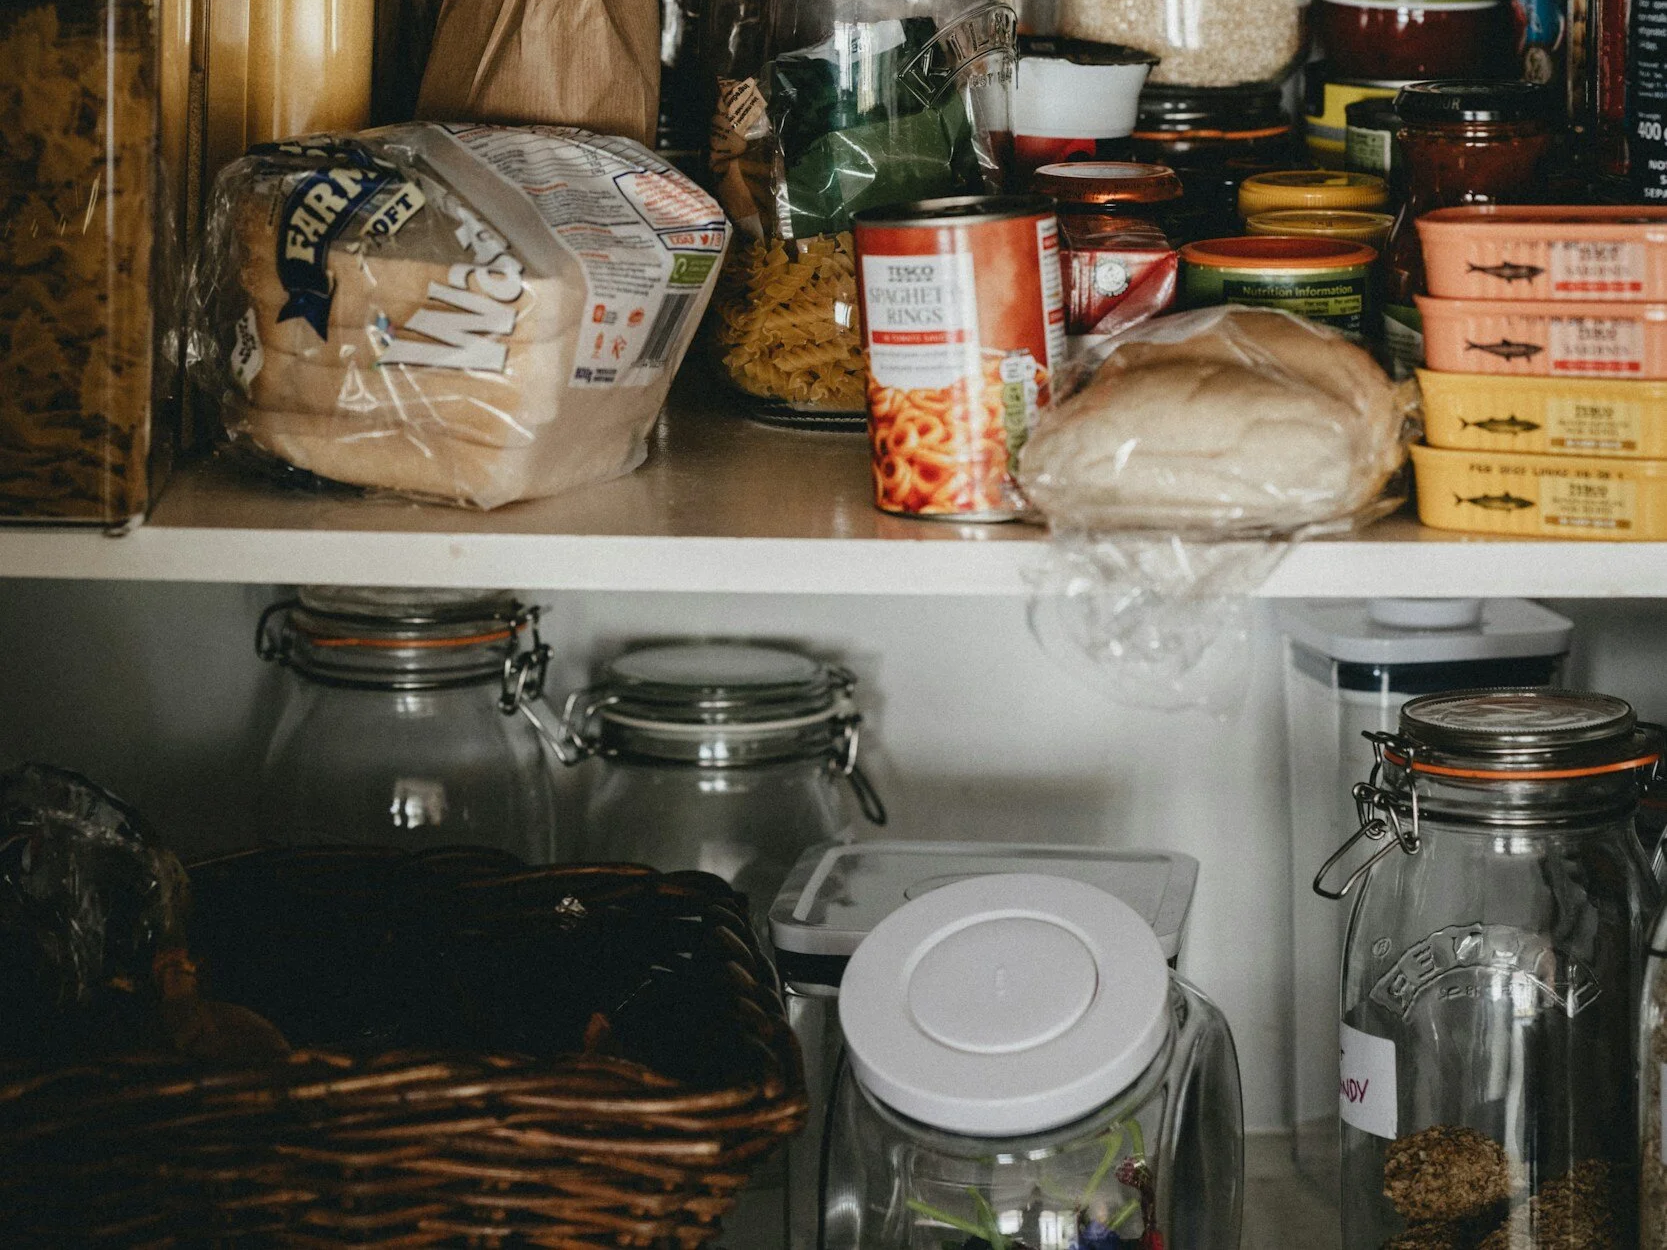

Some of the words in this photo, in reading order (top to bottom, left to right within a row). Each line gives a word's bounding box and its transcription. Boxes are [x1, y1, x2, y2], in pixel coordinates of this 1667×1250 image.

[1637, 121, 1662, 141] 400
[888, 264, 935, 282] TESCO
[868, 286, 958, 306] SPAGHET
[1242, 285, 1292, 297] Nutrition
[1295, 284, 1354, 297] Information
[887, 307, 944, 324] RINGS
